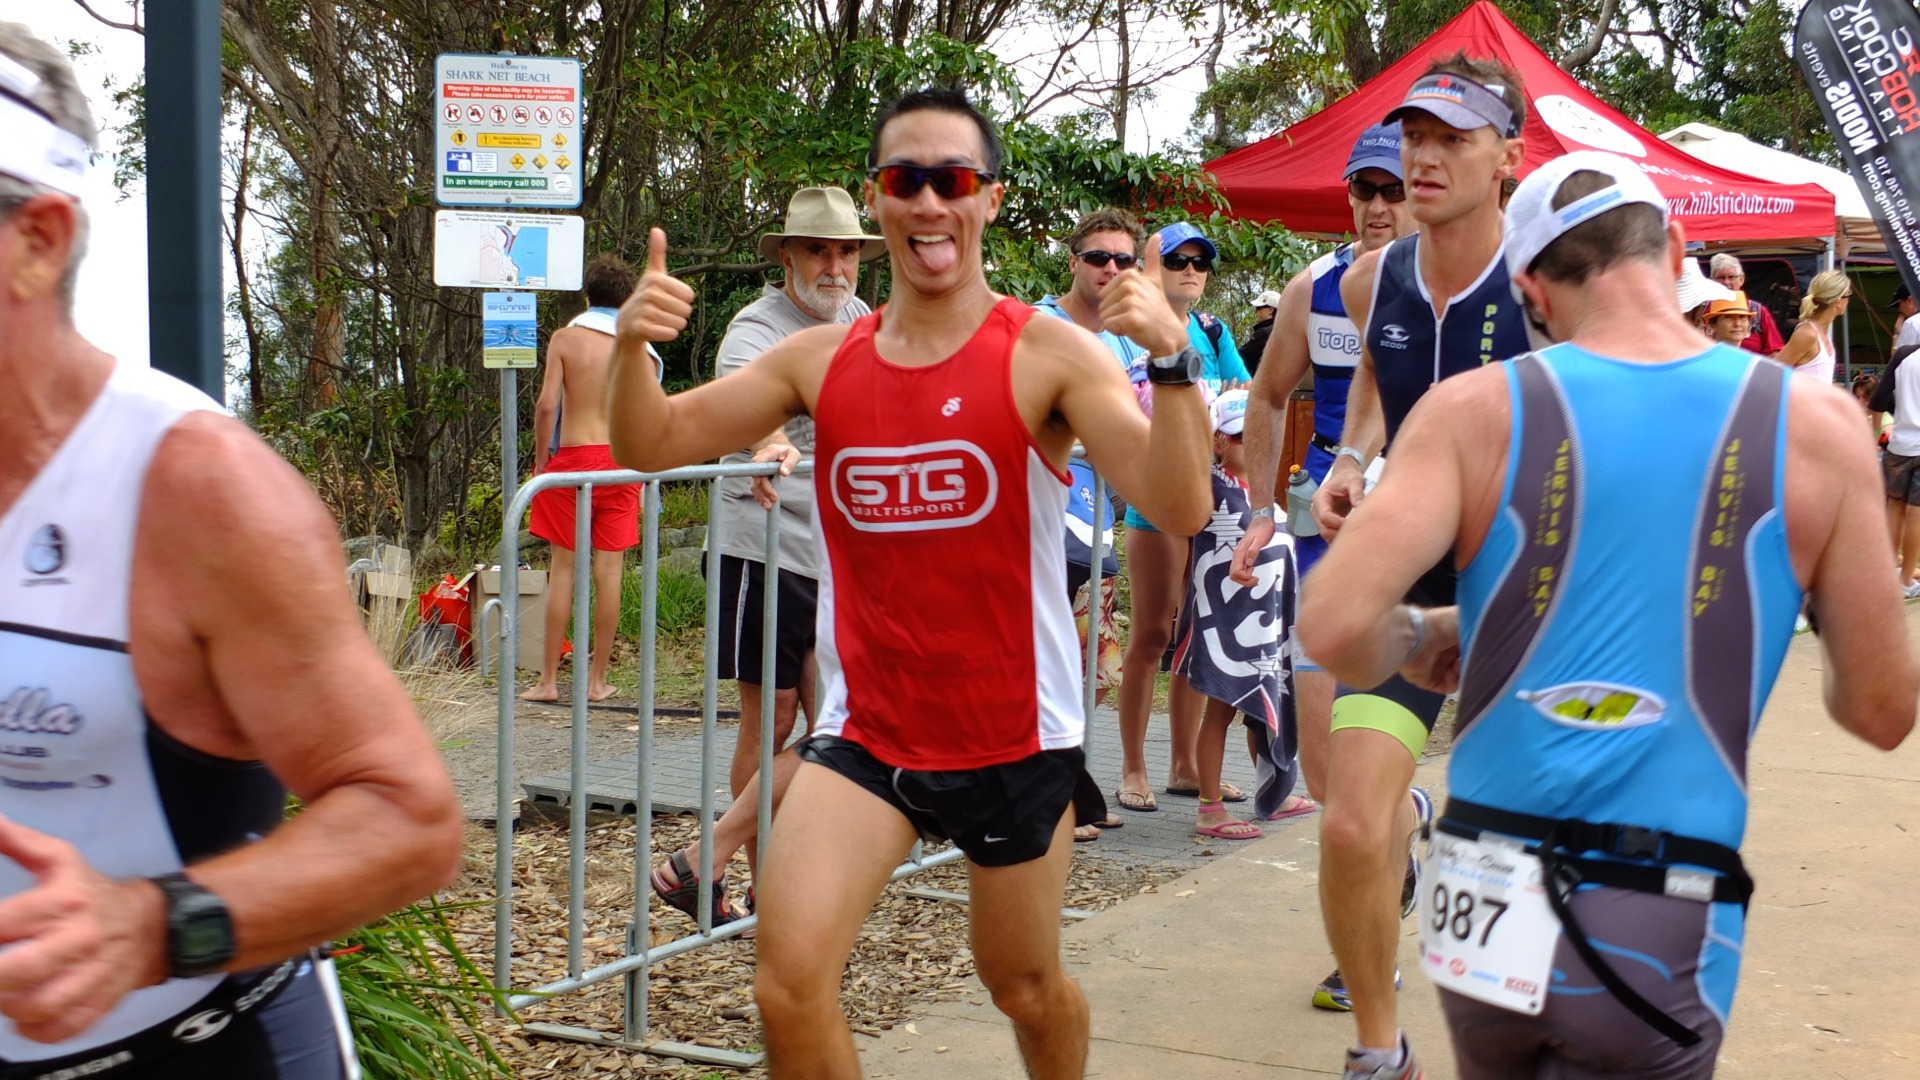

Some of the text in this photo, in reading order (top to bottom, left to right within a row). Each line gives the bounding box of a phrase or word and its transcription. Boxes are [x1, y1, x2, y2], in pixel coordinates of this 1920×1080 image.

[446, 70, 550, 83] SHARK NET BEACH
[446, 177, 454, 185] In
[468, 179, 513, 188] emergency
[515, 178, 529, 186] call
[531, 179, 545, 187] 000
[1318, 328, 1361, 355] Top
[1380, 340, 1408, 351] SCODY
[846, 458, 966, 506] STG
[1545, 438, 1570, 547] JERVIS
[1709, 438, 1742, 547] JERVIS
[851, 502, 967, 517] MULTISPORT
[1533, 566, 1555, 619] BAY
[1693, 565, 1718, 618] BAY
[1432, 882, 1509, 949] 987
